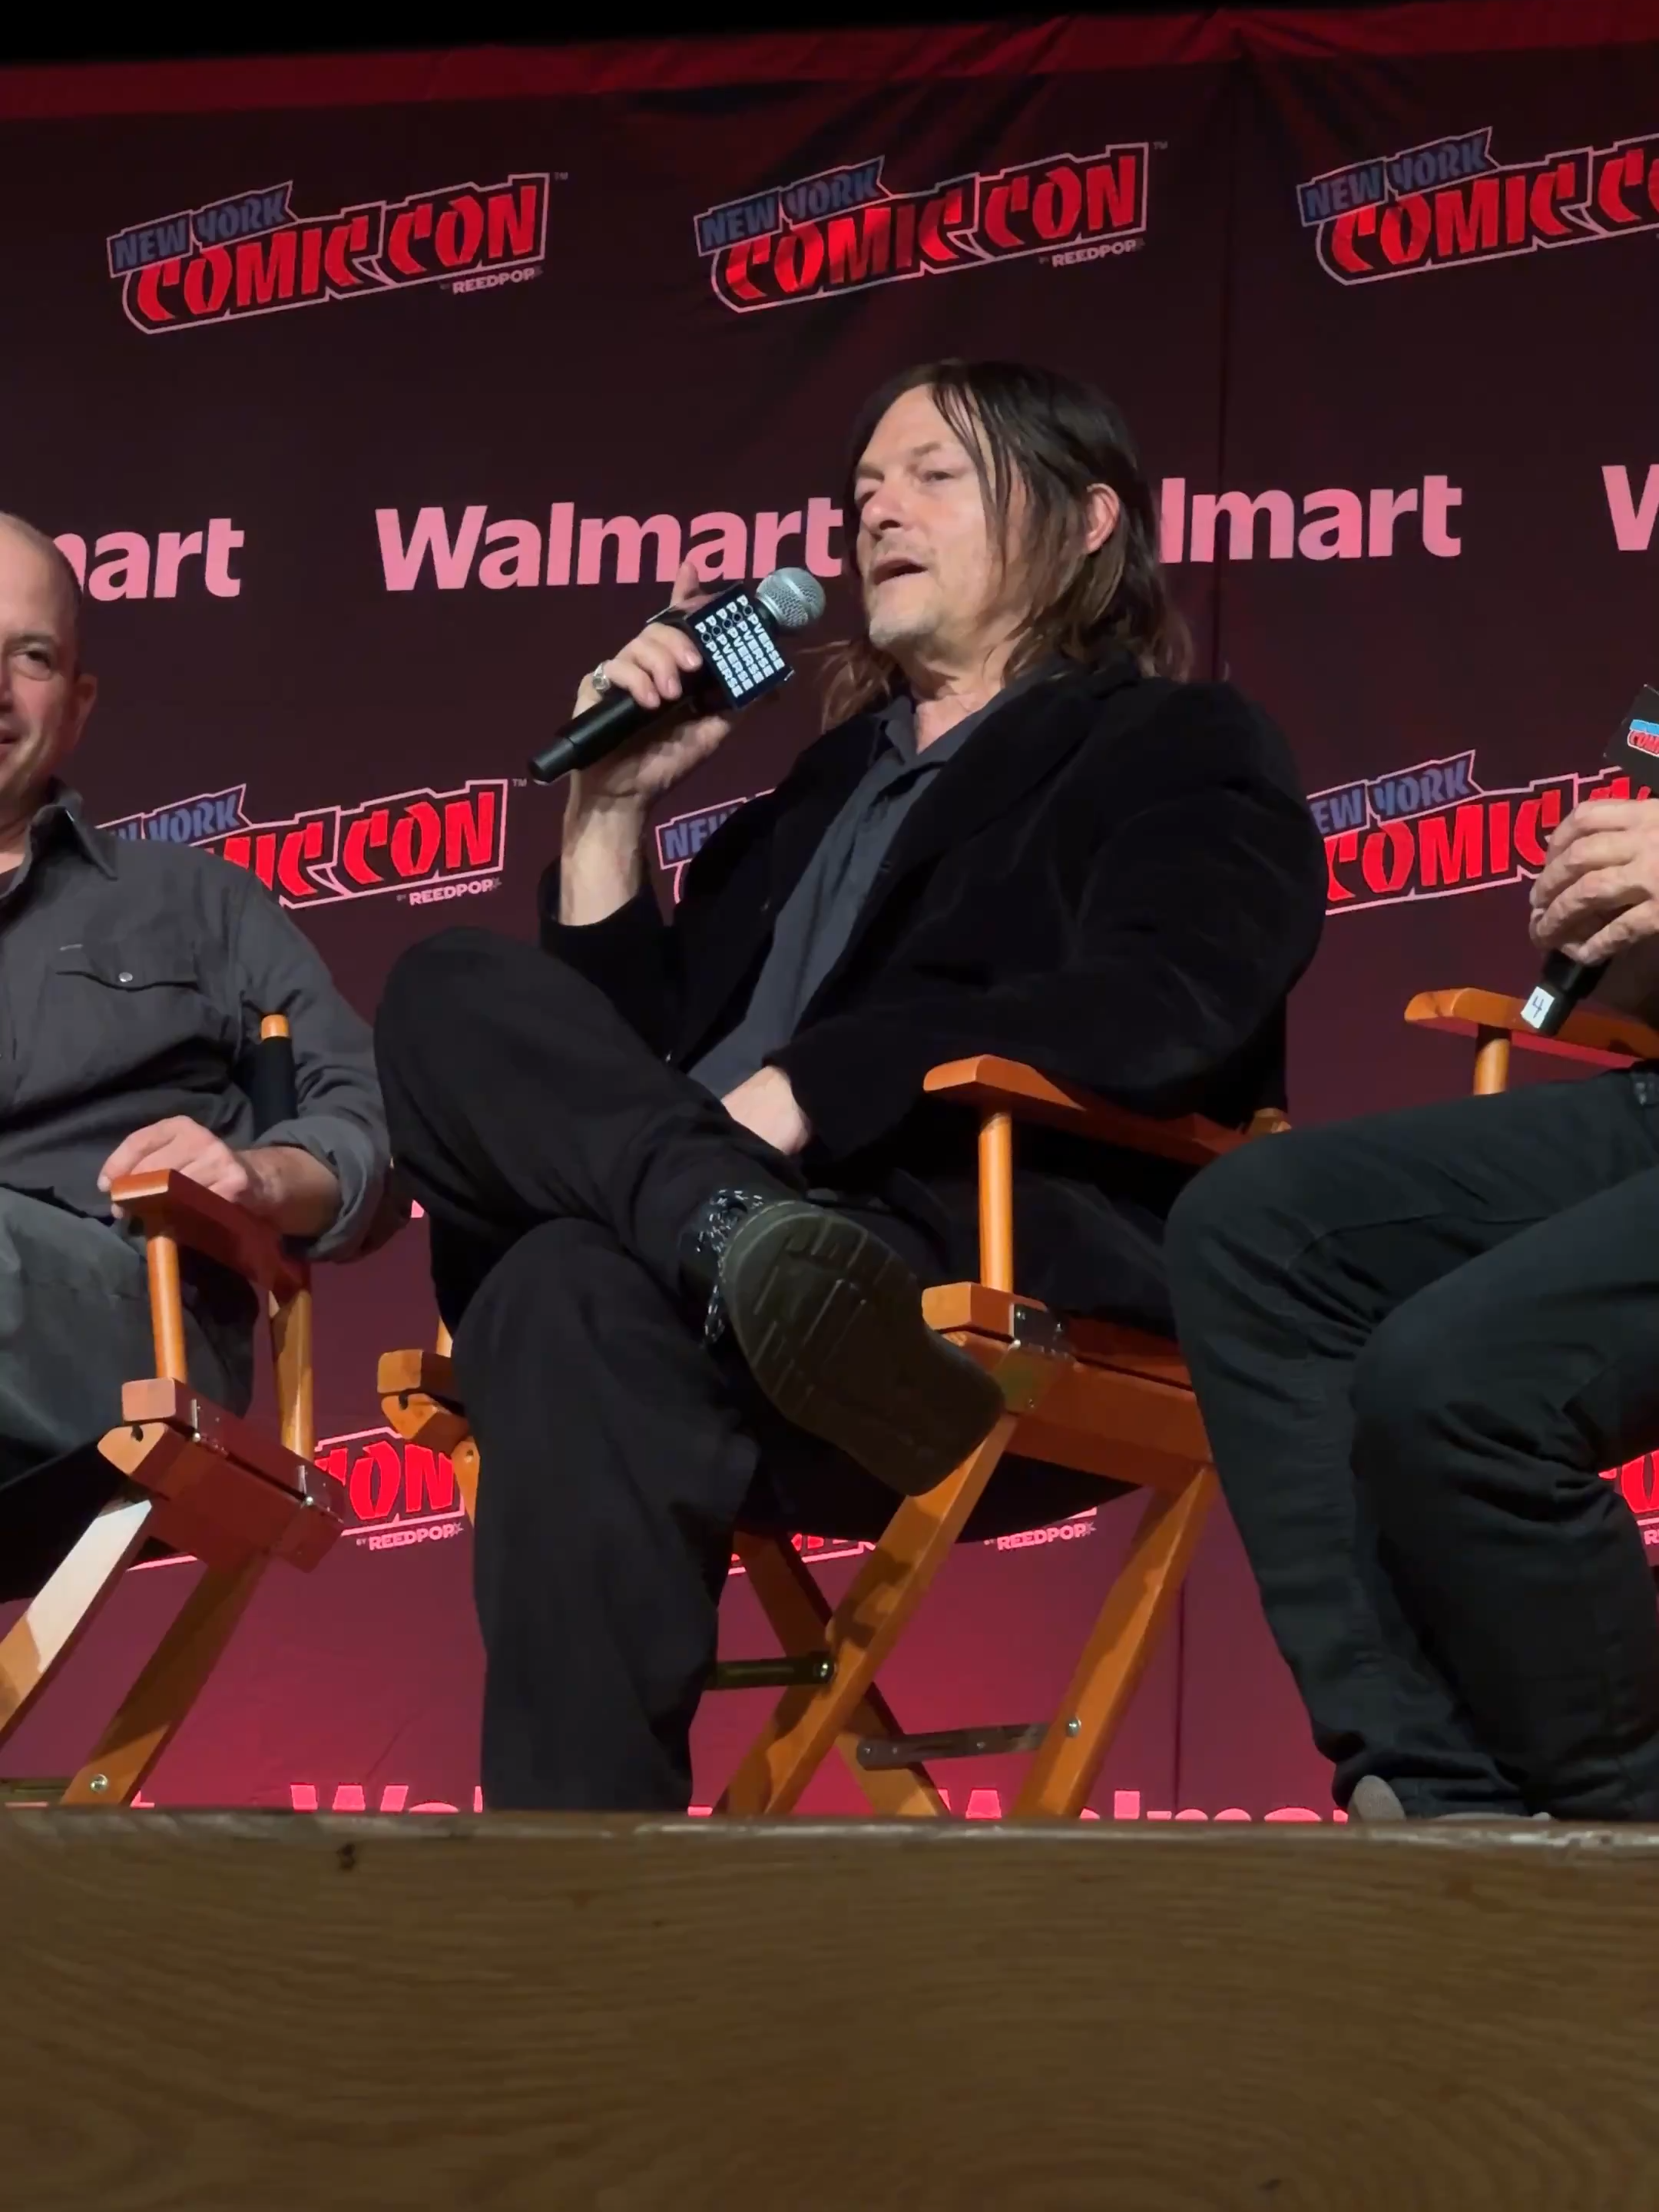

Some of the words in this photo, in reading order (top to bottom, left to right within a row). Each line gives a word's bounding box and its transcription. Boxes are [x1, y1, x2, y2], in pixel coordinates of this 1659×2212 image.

[701, 197, 777, 248] NEW
[786, 165, 881, 220] YORK
[1306, 167, 1381, 217] NEW
[1392, 137, 1487, 190] YORK
[114, 219, 187, 270] NEW
[197, 192, 286, 243] YORK
[137, 216, 369, 321] COMIC
[388, 185, 536, 275] CON
[725, 188, 962, 300] COMIC
[985, 155, 1136, 247] CON
[1051, 239, 1137, 267] REEDPOP
[1331, 162, 1575, 273] COMIC
[452, 267, 535, 294] REEDPOP
[375, 498, 843, 591] Walmart
[1160, 475, 1462, 564] lmart
[148, 794, 240, 843] YORK
[1310, 788, 1362, 835] EW
[1373, 760, 1471, 816] YORK
[343, 791, 495, 884] CON
[409, 879, 493, 906] REEDPOP
[369, 1524, 455, 1551] REEDPOP
[997, 1523, 1086, 1551] REEDPOP
